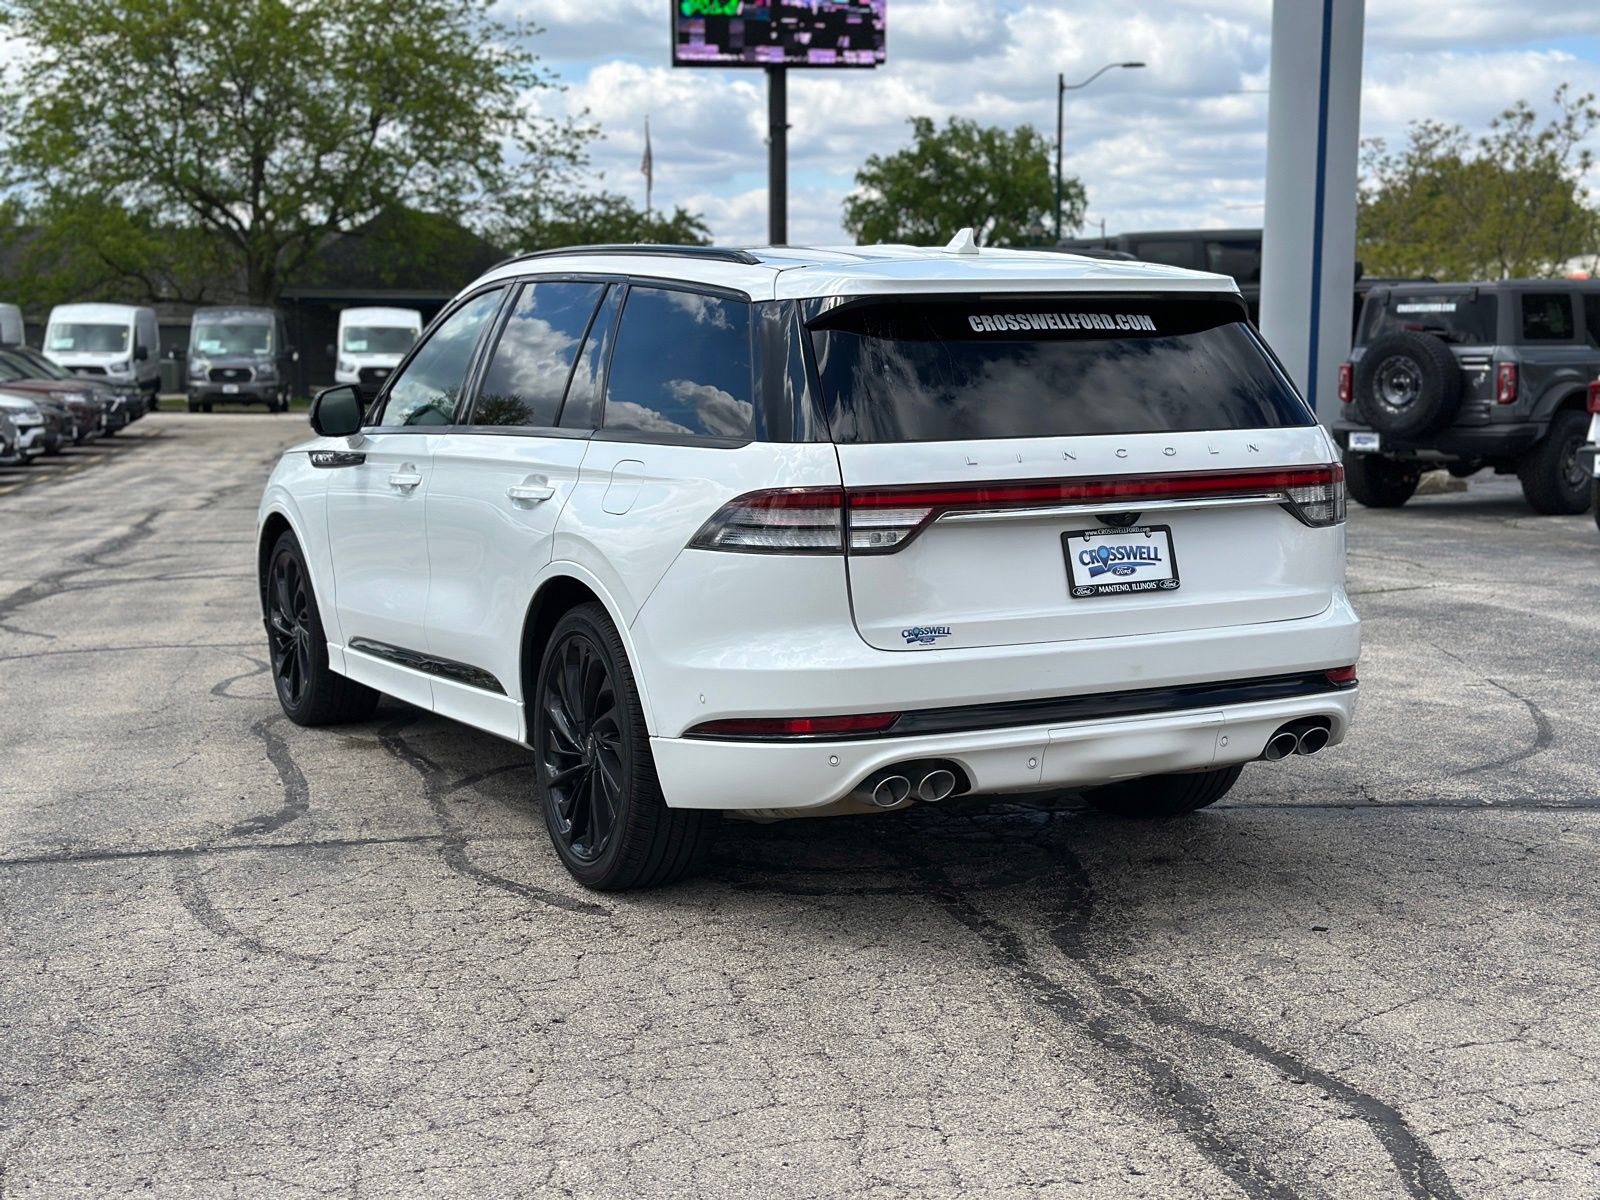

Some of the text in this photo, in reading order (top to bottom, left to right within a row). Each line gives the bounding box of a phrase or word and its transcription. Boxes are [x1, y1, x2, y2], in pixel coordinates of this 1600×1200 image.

[968, 313, 1156, 332] CROSSWELLFORD.COM
[965, 442, 1260, 466] LINCOLN
[1078, 545, 1162, 568] CROSSWELL
[1098, 584, 1131, 593] MANTENO,
[1131, 581, 1157, 590] ILLINOIS
[901, 626, 952, 638] CROSSWELL
